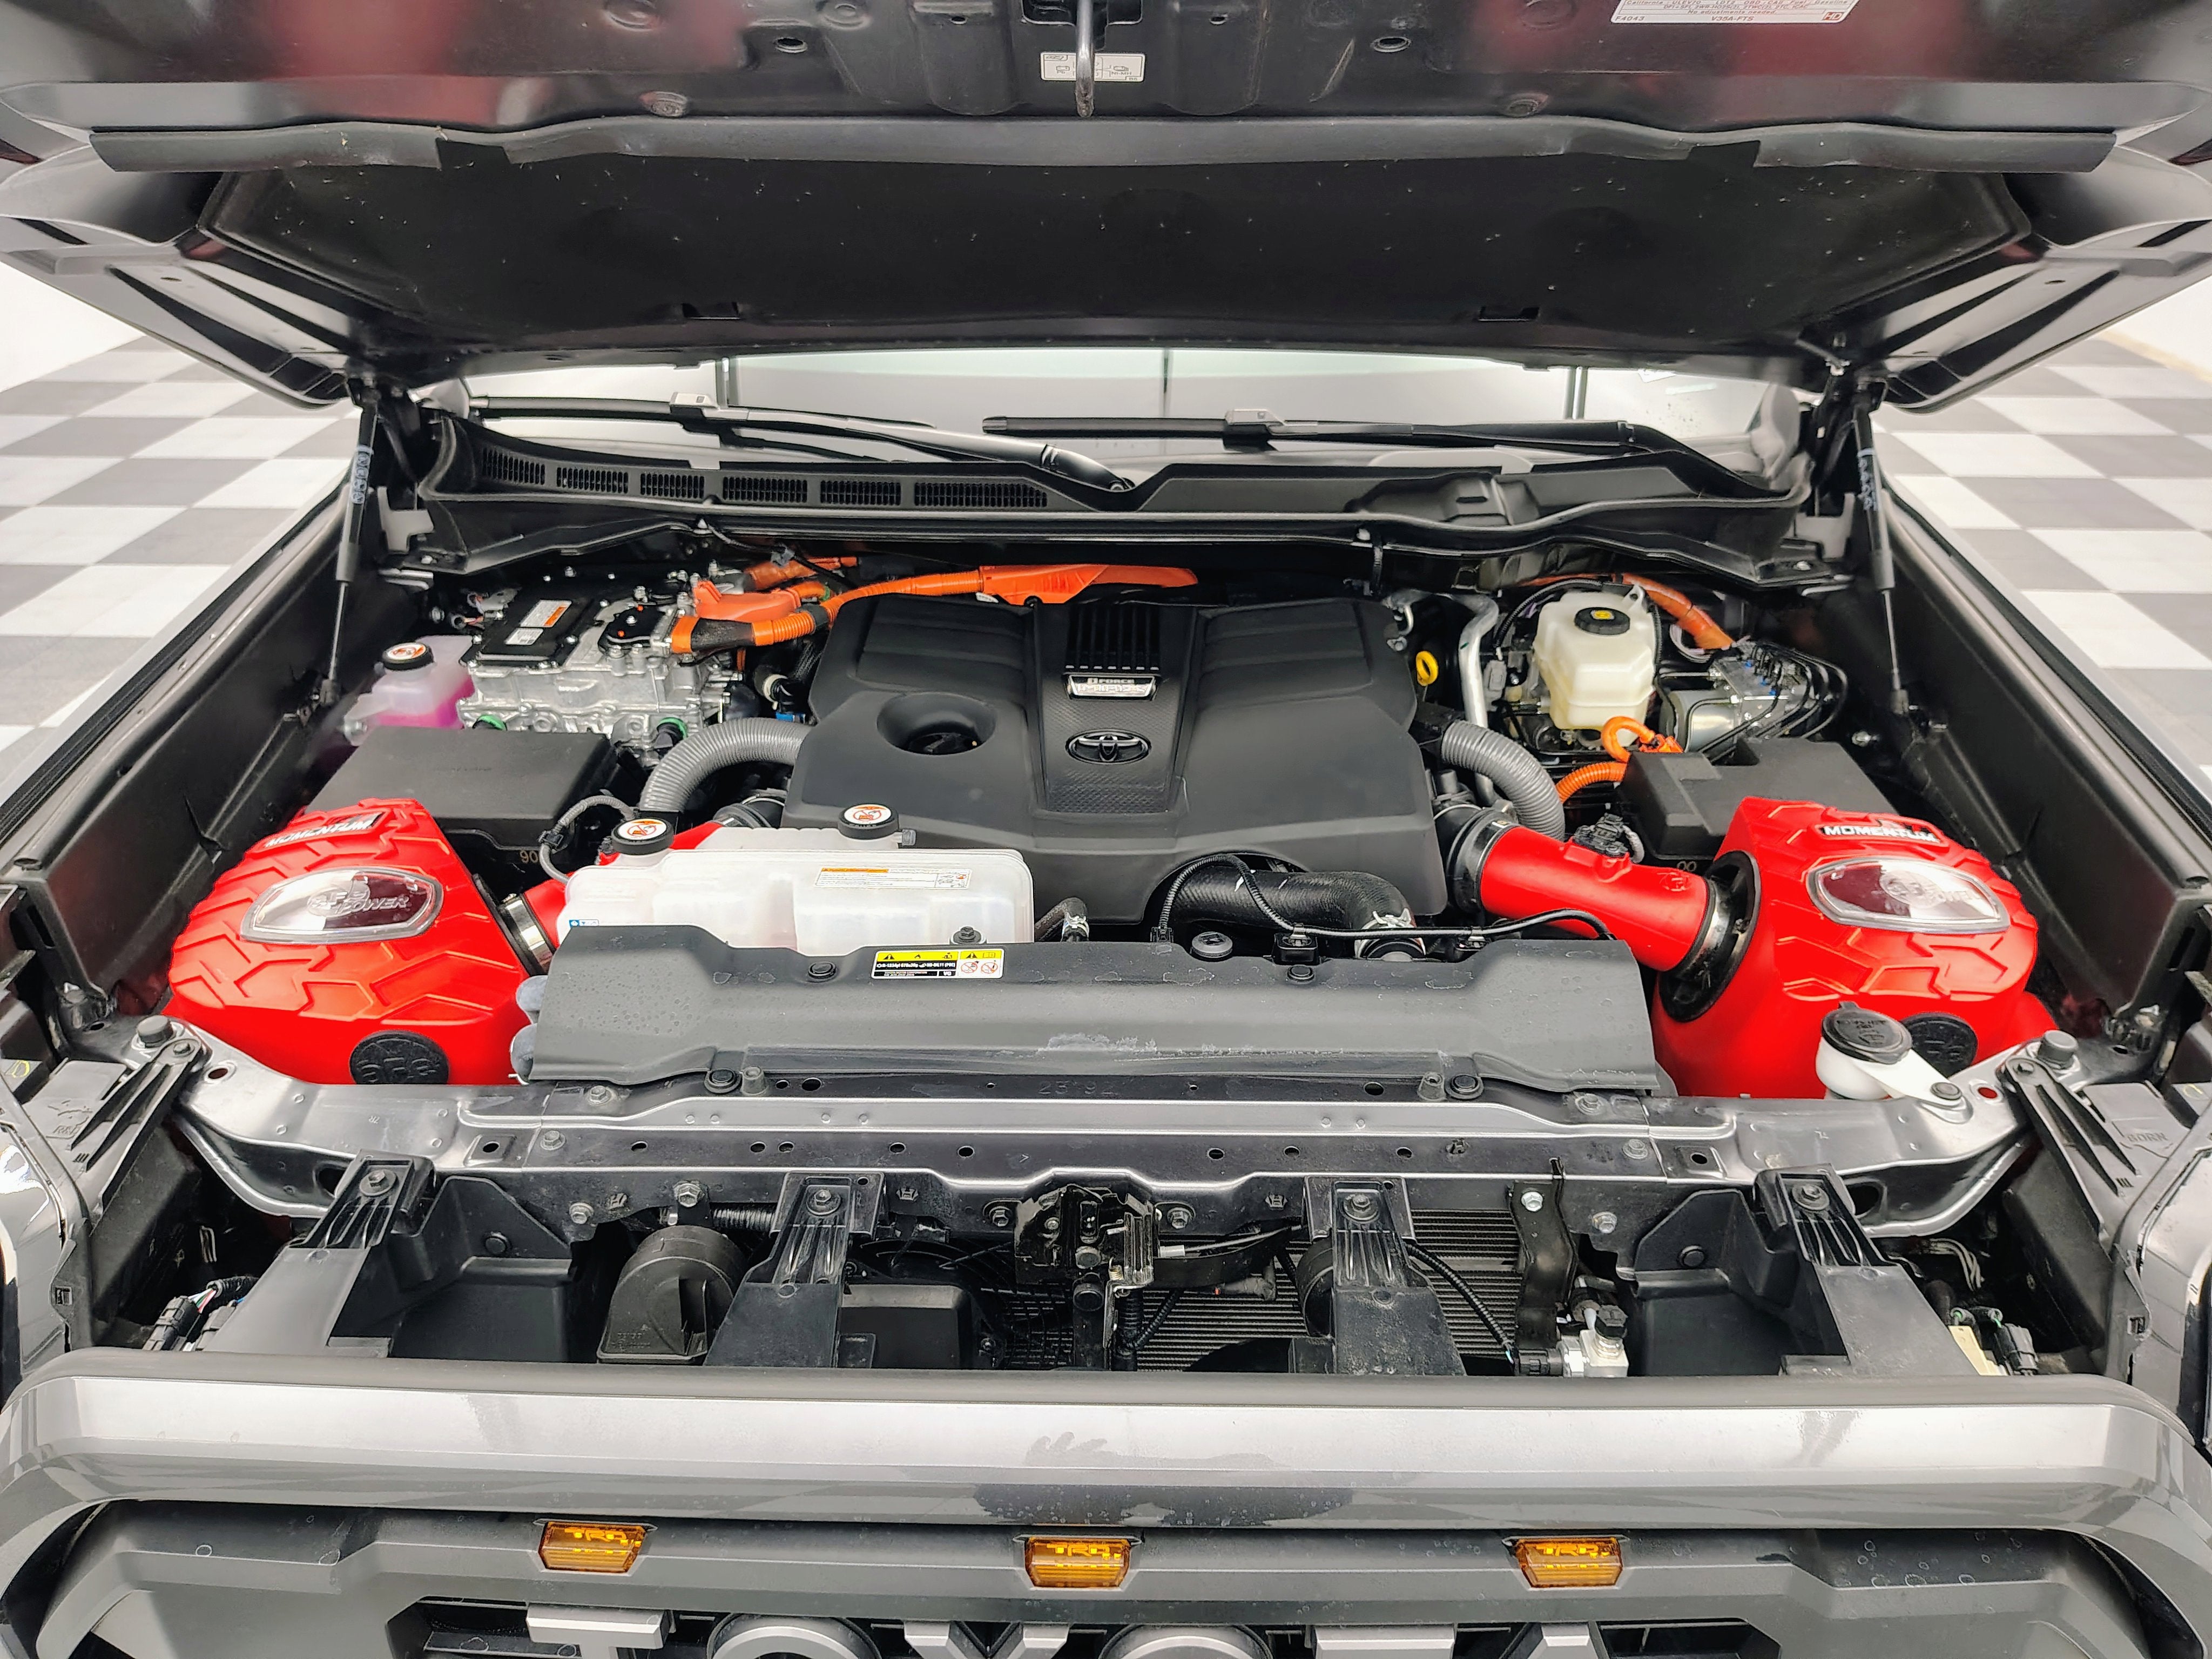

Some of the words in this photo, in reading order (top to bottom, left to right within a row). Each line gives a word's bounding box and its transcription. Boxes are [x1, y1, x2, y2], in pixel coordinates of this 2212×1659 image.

[1823, 12, 1843, 20] HD
[264, 818, 375, 848] MOMENTUM
[1824, 826, 1941, 842] MOMENTUM
[2127, 1132, 2169, 1142] BORN
[564, 1527, 627, 1542] TRD
[1046, 1543, 1110, 1557] TRD
